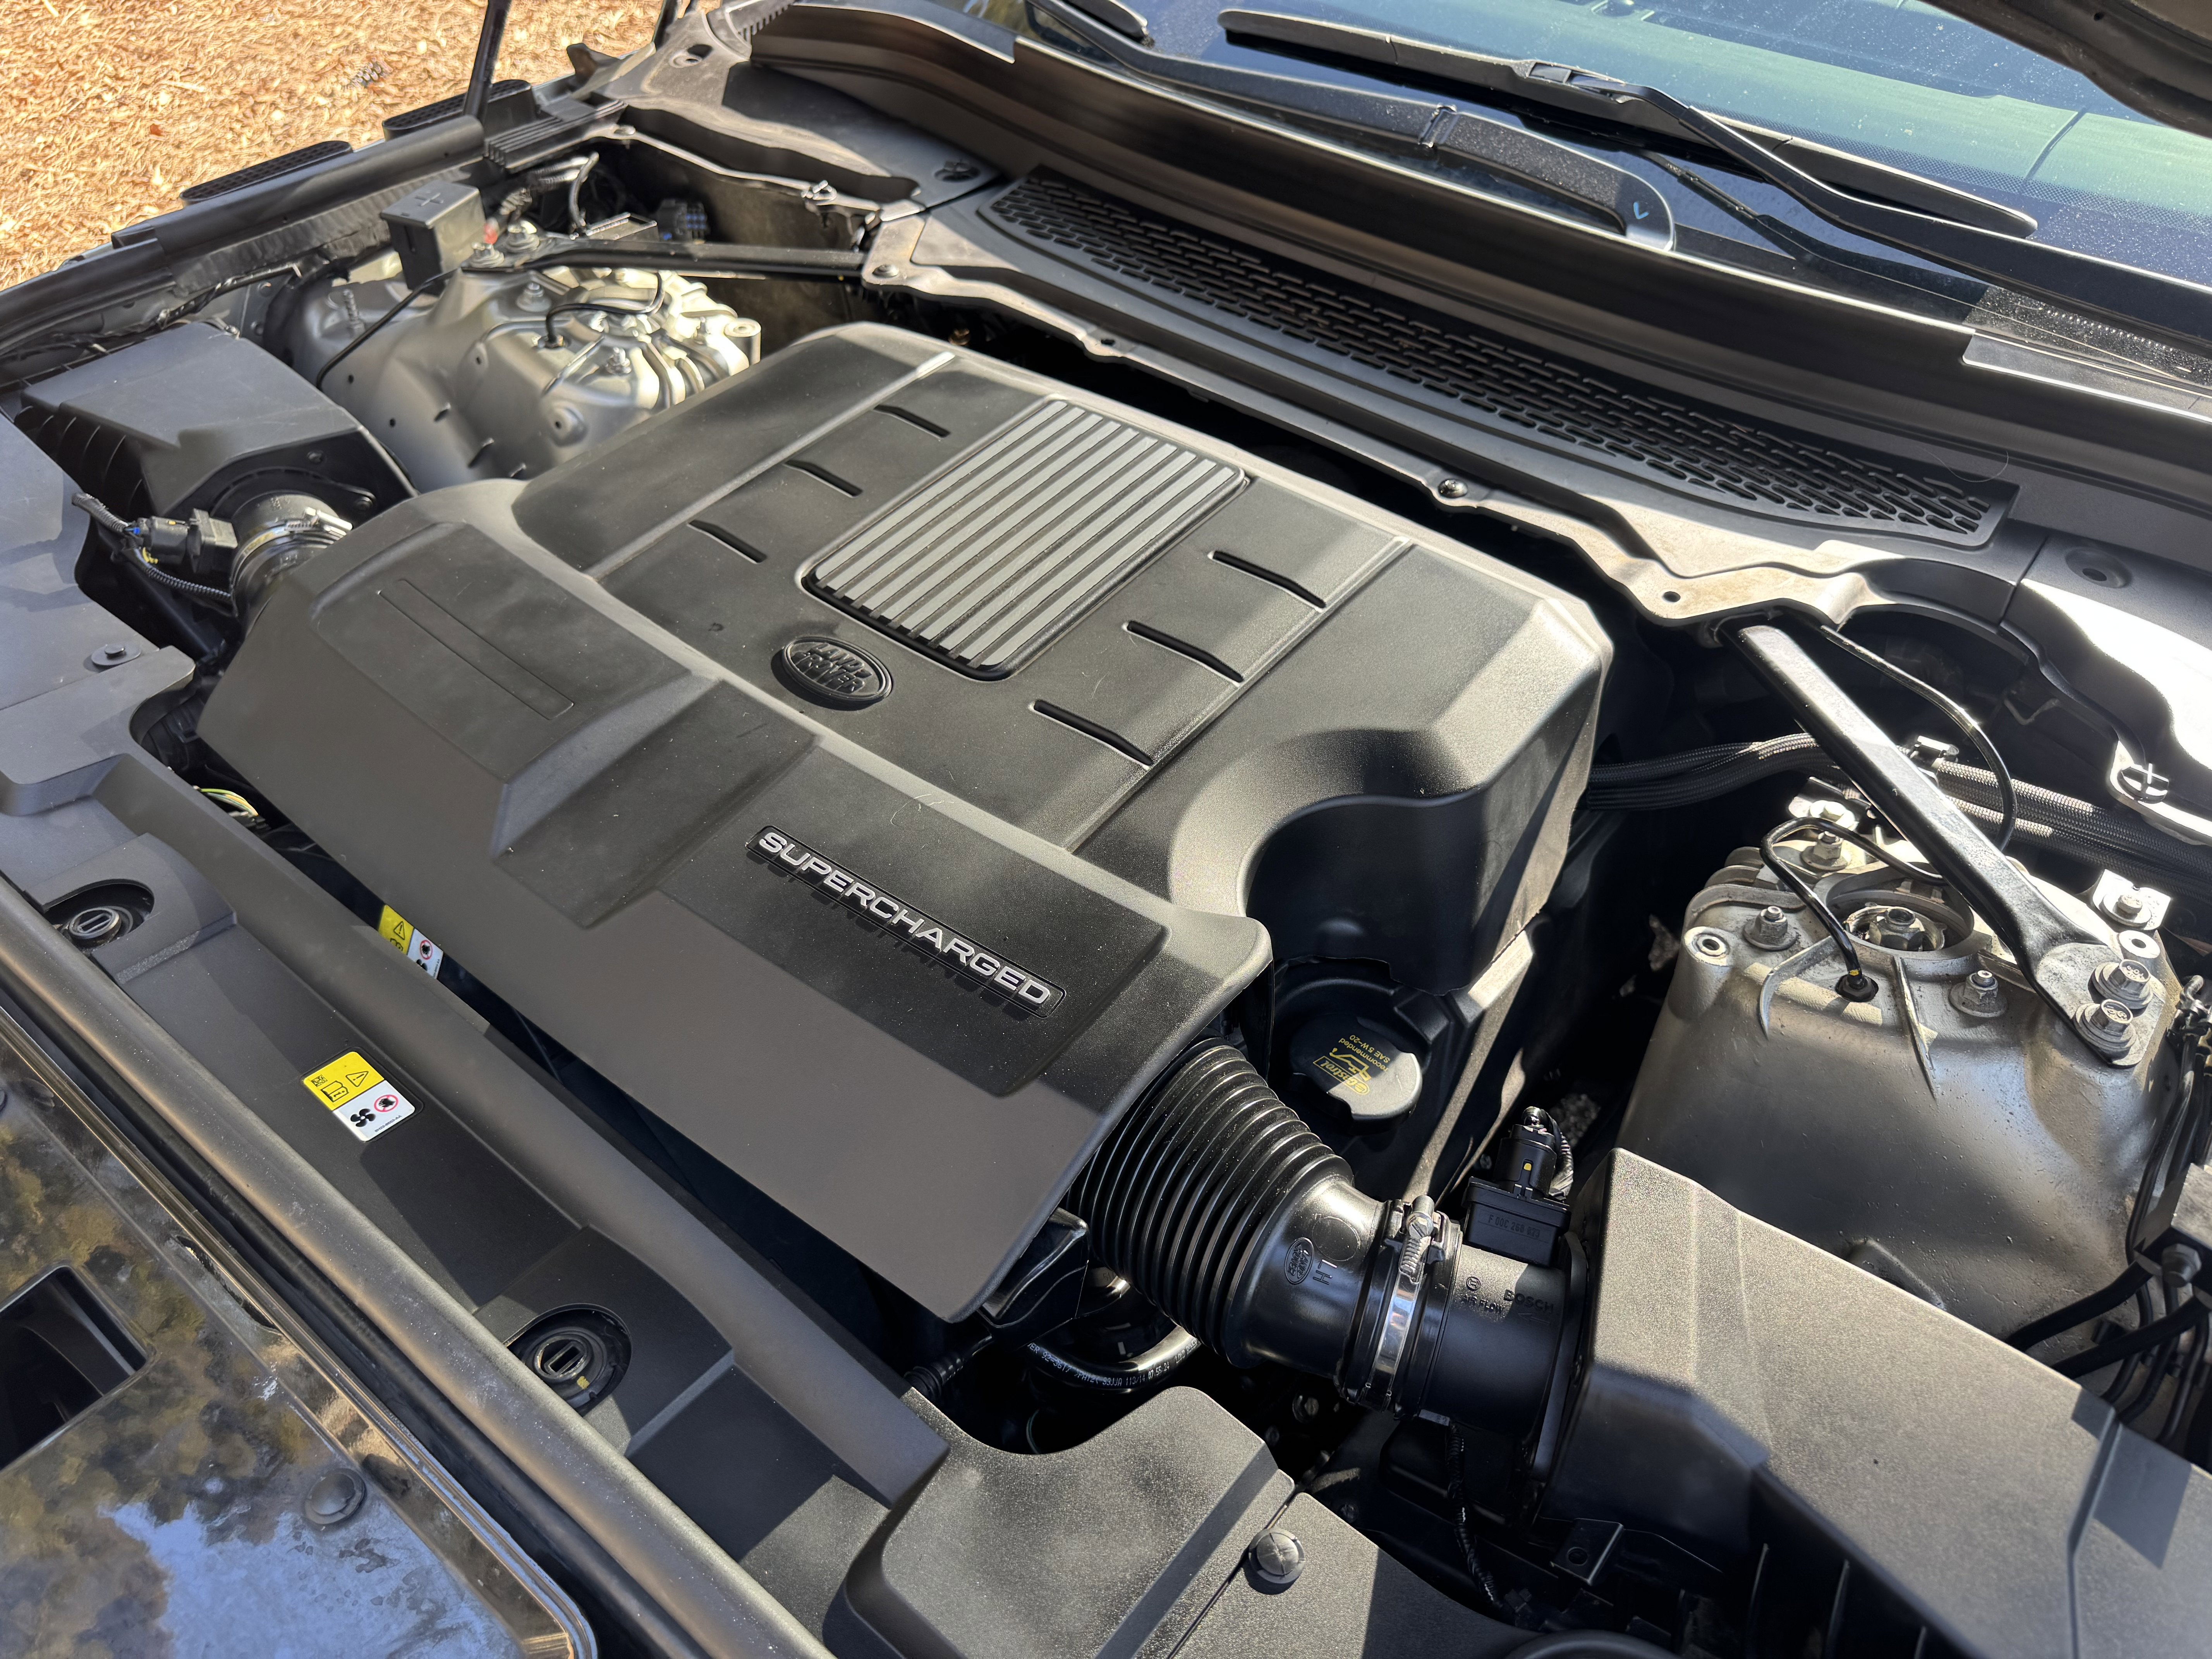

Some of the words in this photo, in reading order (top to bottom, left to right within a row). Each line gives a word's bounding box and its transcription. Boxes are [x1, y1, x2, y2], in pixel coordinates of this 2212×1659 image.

[759, 832, 1051, 1005] SUPERCHARGED
[1338, 1038, 1389, 1072] recommended
[1374, 1051, 1390, 1063] SAE
[1321, 1060, 1358, 1084] Castrol
[1488, 1214, 1494, 1223] F
[1312, 1259, 1337, 1285] LH
[1504, 1289, 1554, 1314] BOSCH
